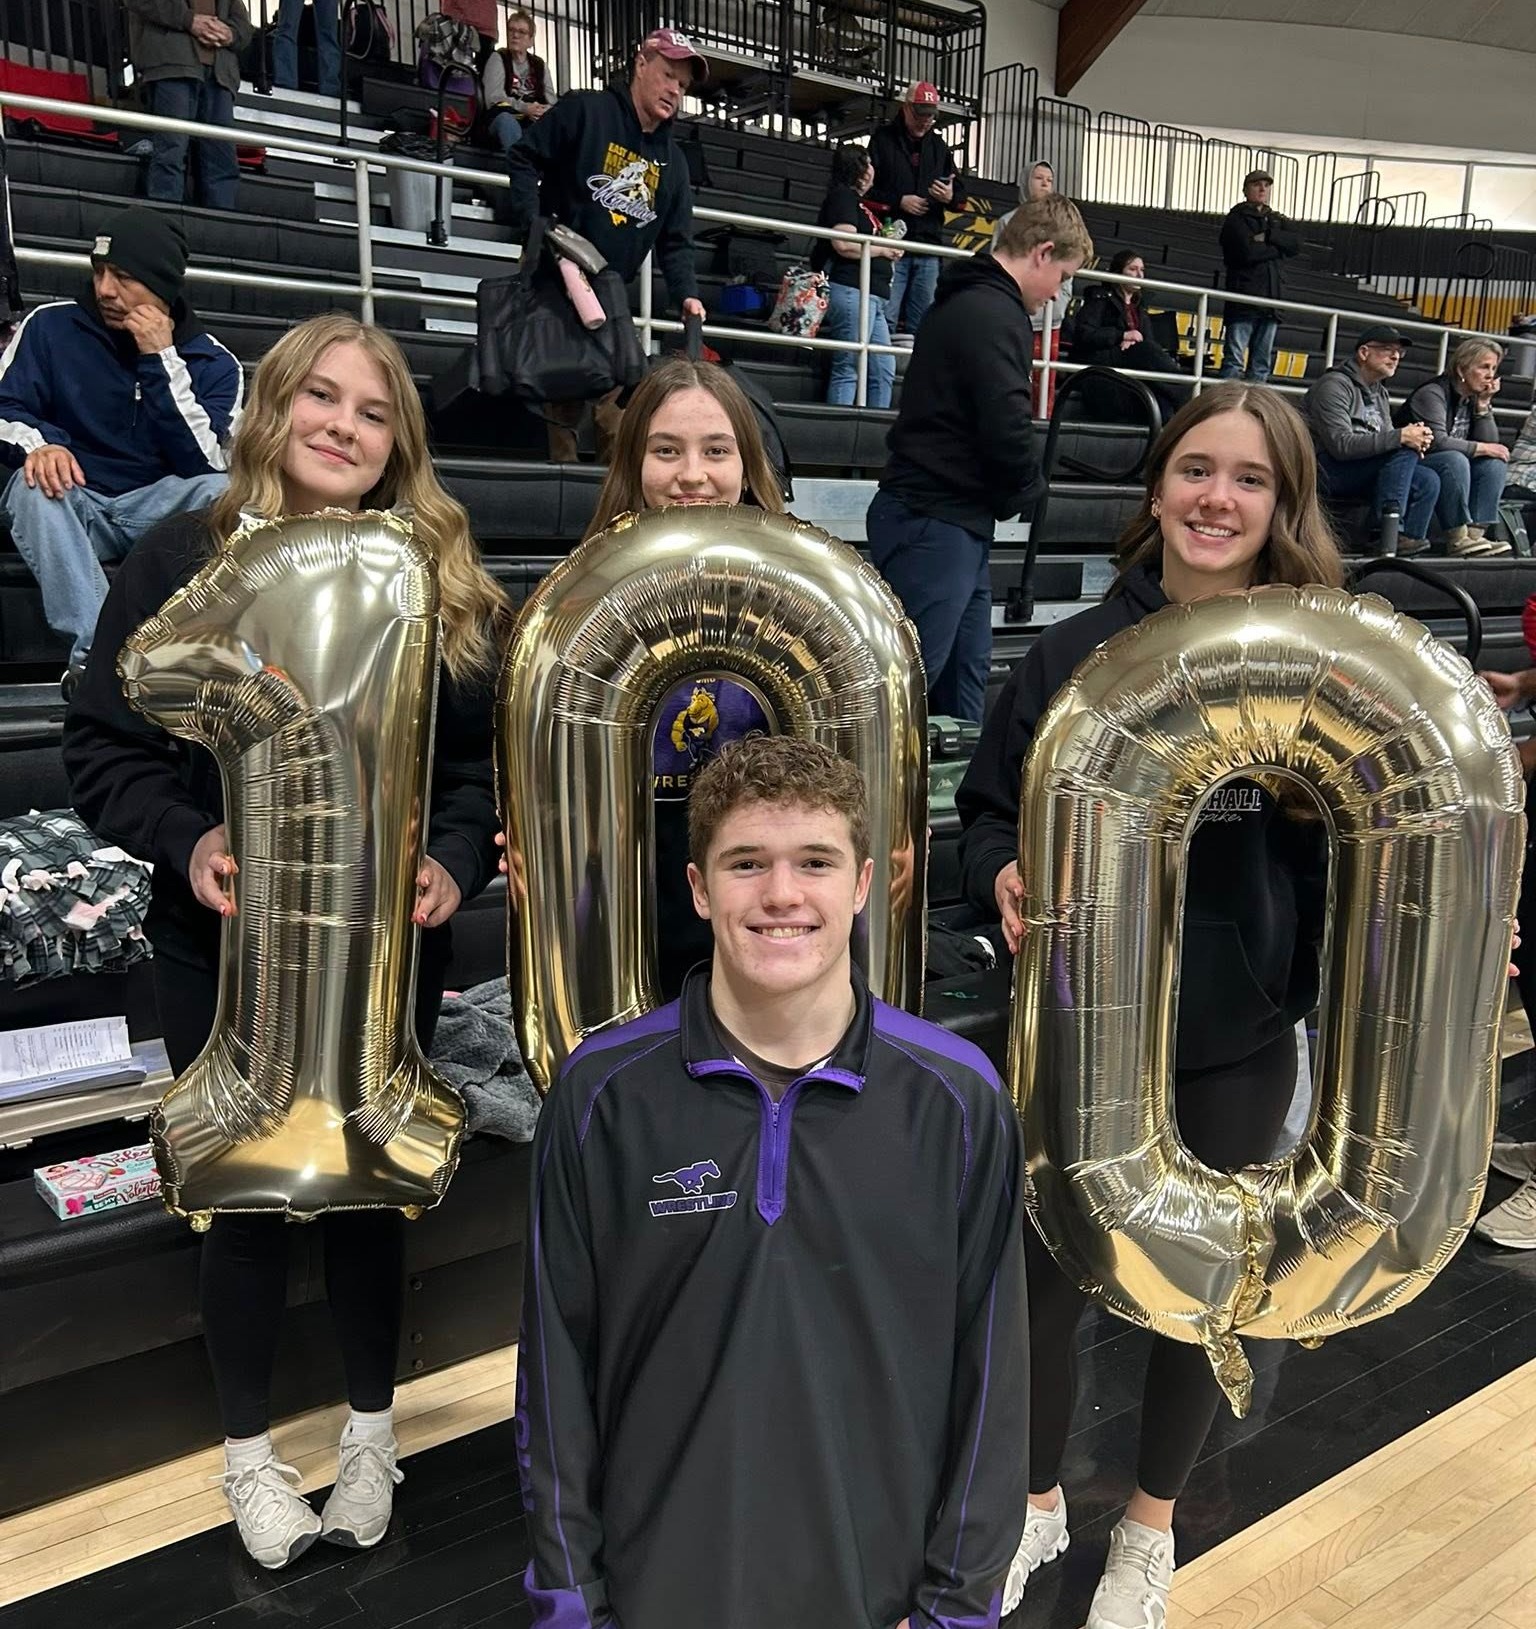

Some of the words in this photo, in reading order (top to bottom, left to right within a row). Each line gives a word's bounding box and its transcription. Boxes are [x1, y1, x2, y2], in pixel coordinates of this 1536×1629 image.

[924, 91, 935, 102] R
[1201, 788, 1262, 812] HALL
[649, 1190, 738, 1217] WRESTLING
